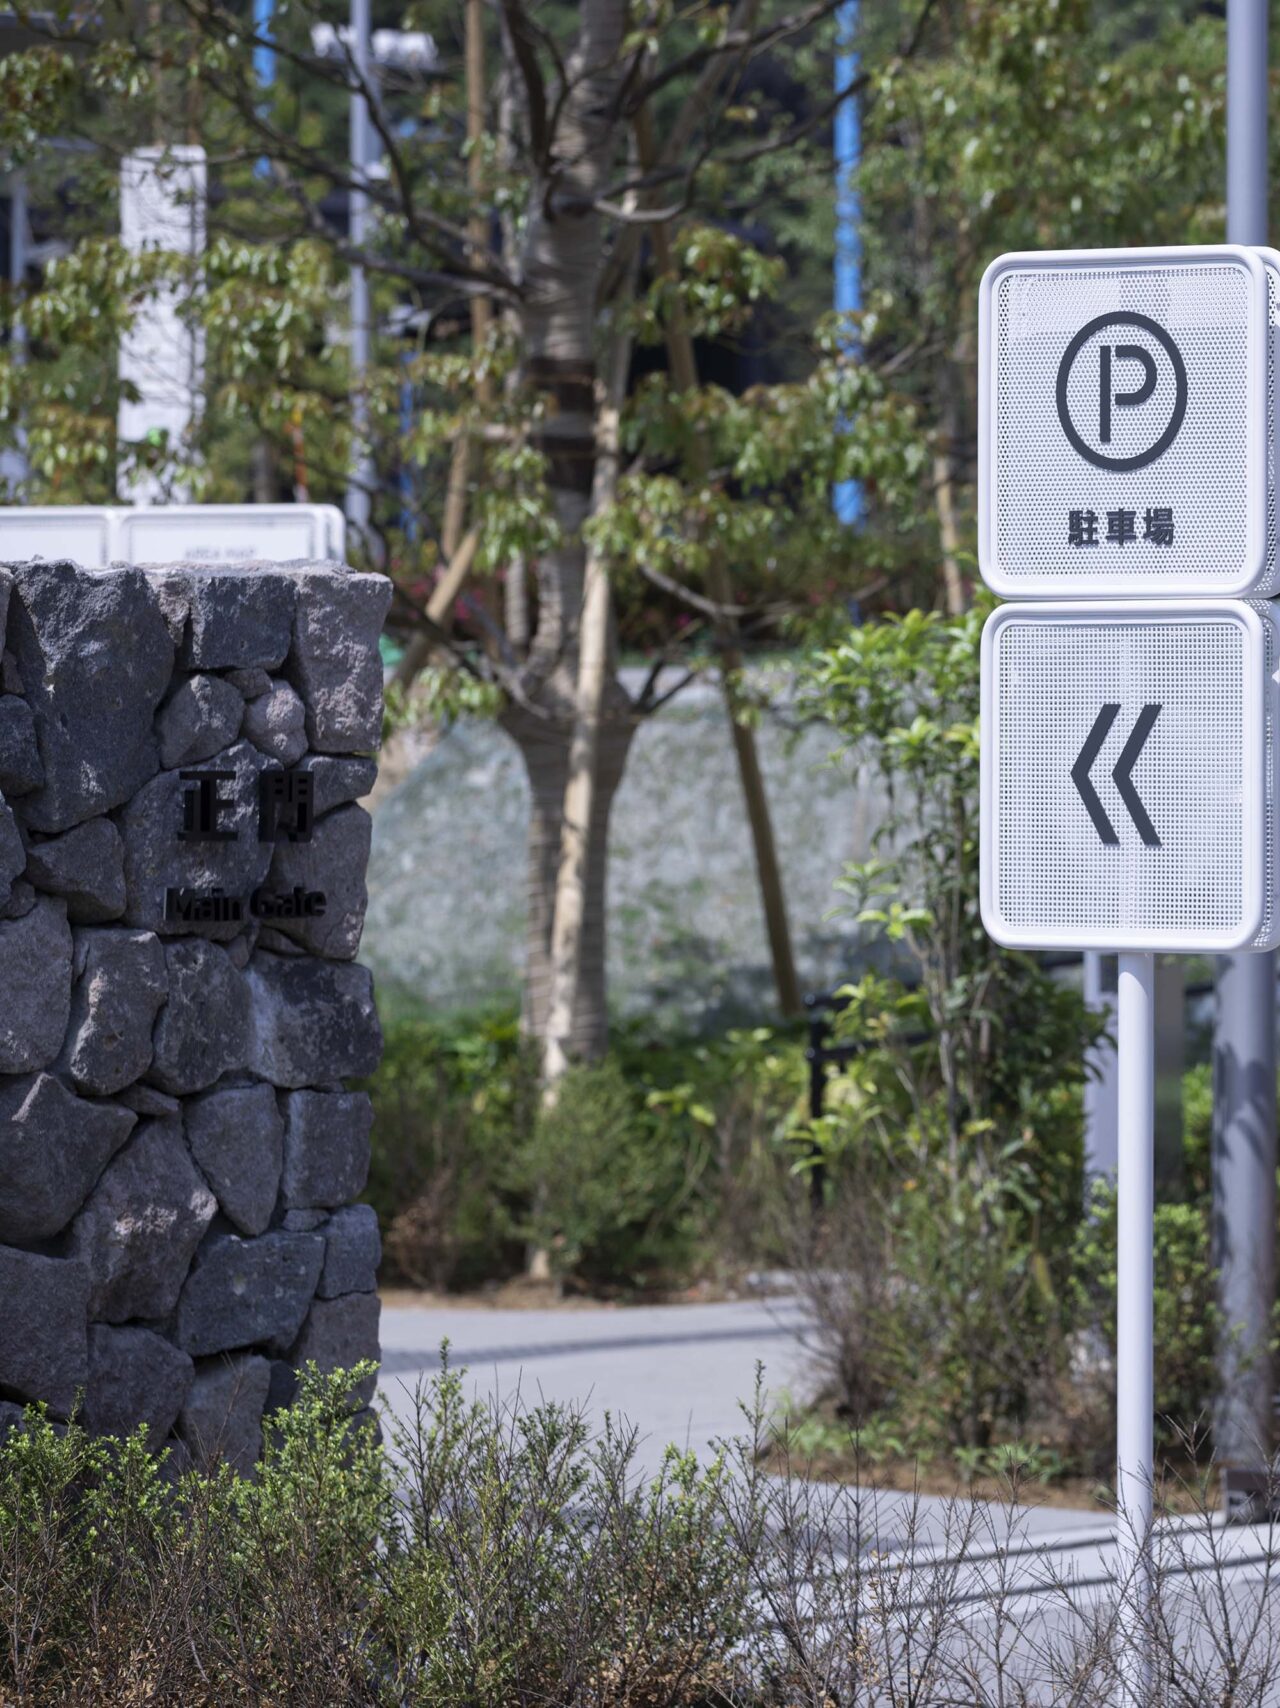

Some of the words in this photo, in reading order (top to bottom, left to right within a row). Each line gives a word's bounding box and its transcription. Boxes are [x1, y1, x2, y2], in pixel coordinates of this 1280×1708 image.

[1100, 344, 1158, 444] P
[1068, 508, 1175, 548] 駐車場
[177, 770, 315, 842] 正門
[164, 886, 244, 921] Main
[250, 886, 327, 918] Gate
